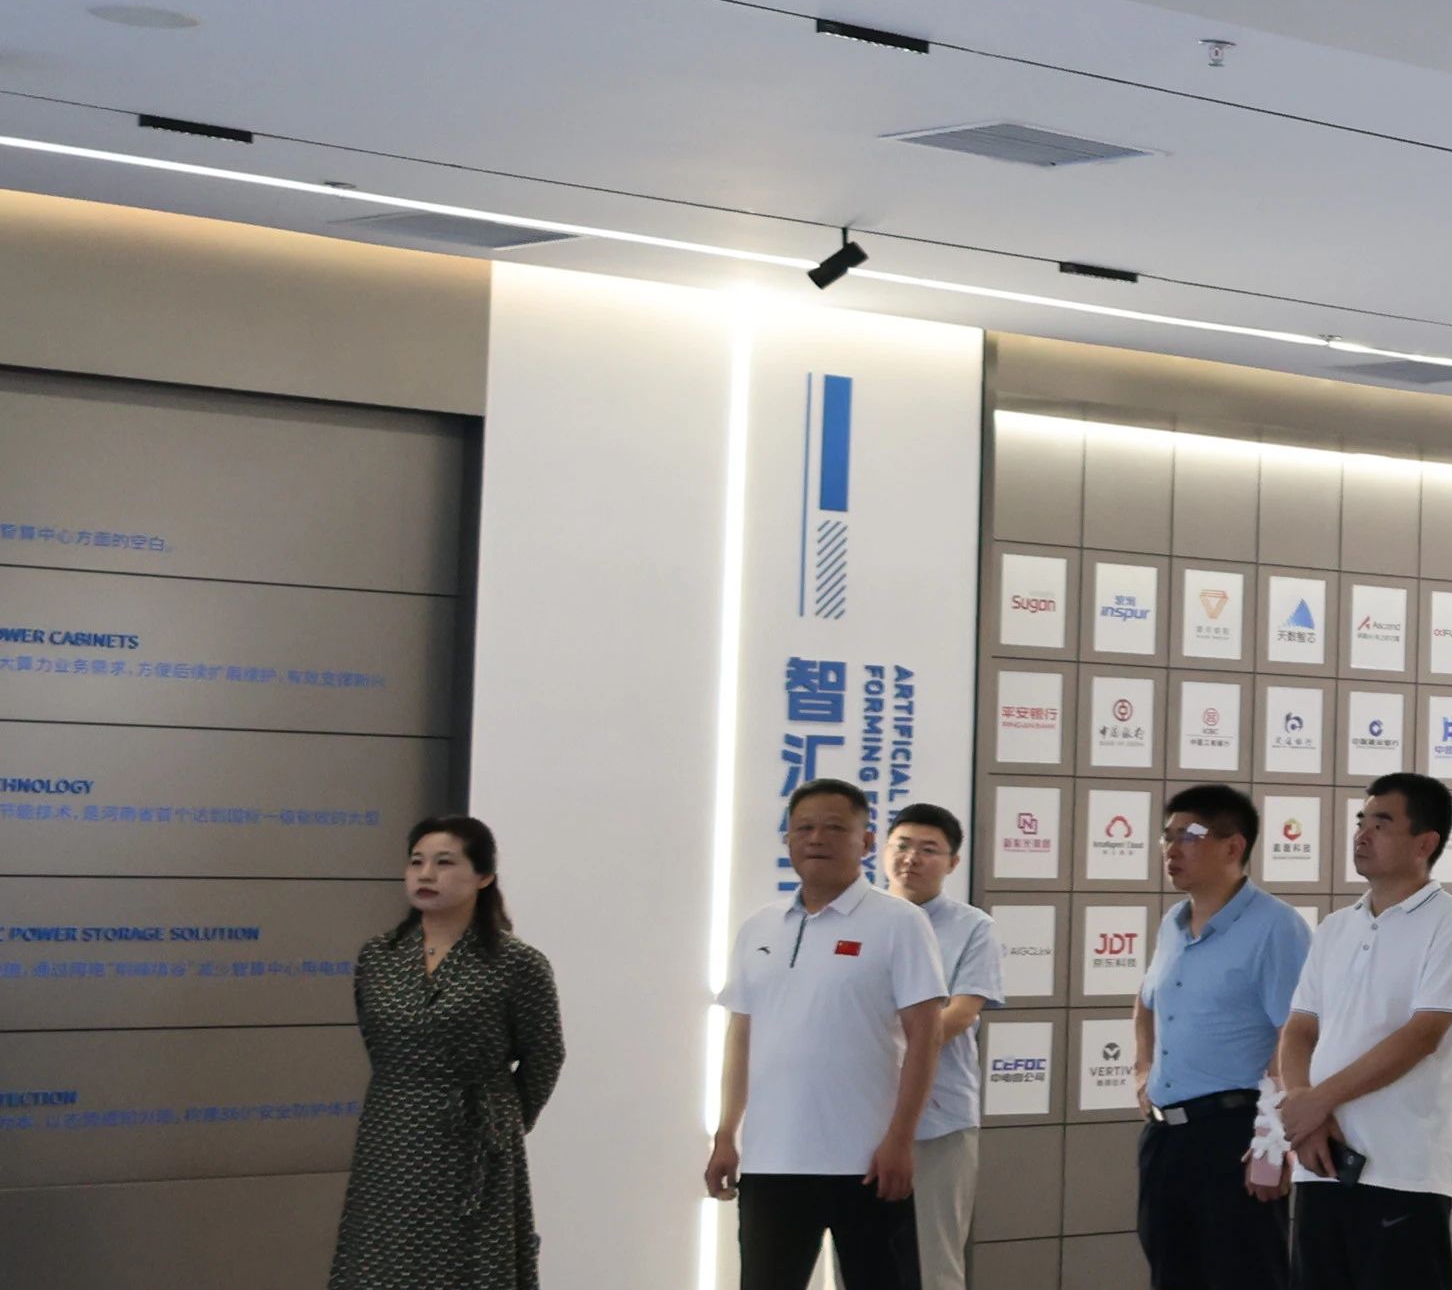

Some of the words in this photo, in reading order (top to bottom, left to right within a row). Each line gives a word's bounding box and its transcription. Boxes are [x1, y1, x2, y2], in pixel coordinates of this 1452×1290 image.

[1011, 595, 1056, 613] Sugon
[1100, 606, 1150, 621] inspur
[0, 628, 45, 644] WER
[50, 631, 140, 650] CABINETS
[1001, 706, 1058, 721] 平安银行
[859, 665, 885, 782] FORMING
[887, 664, 914, 802] ARTIFICIAL
[0, 777, 94, 794] HNOLOGY
[10, 927, 78, 942] POWER
[82, 927, 165, 941] STORAGE
[170, 927, 260, 941] SOLUTION
[1094, 933, 1138, 955] JDT
[1089, 1066, 1133, 1077] VERTIV
